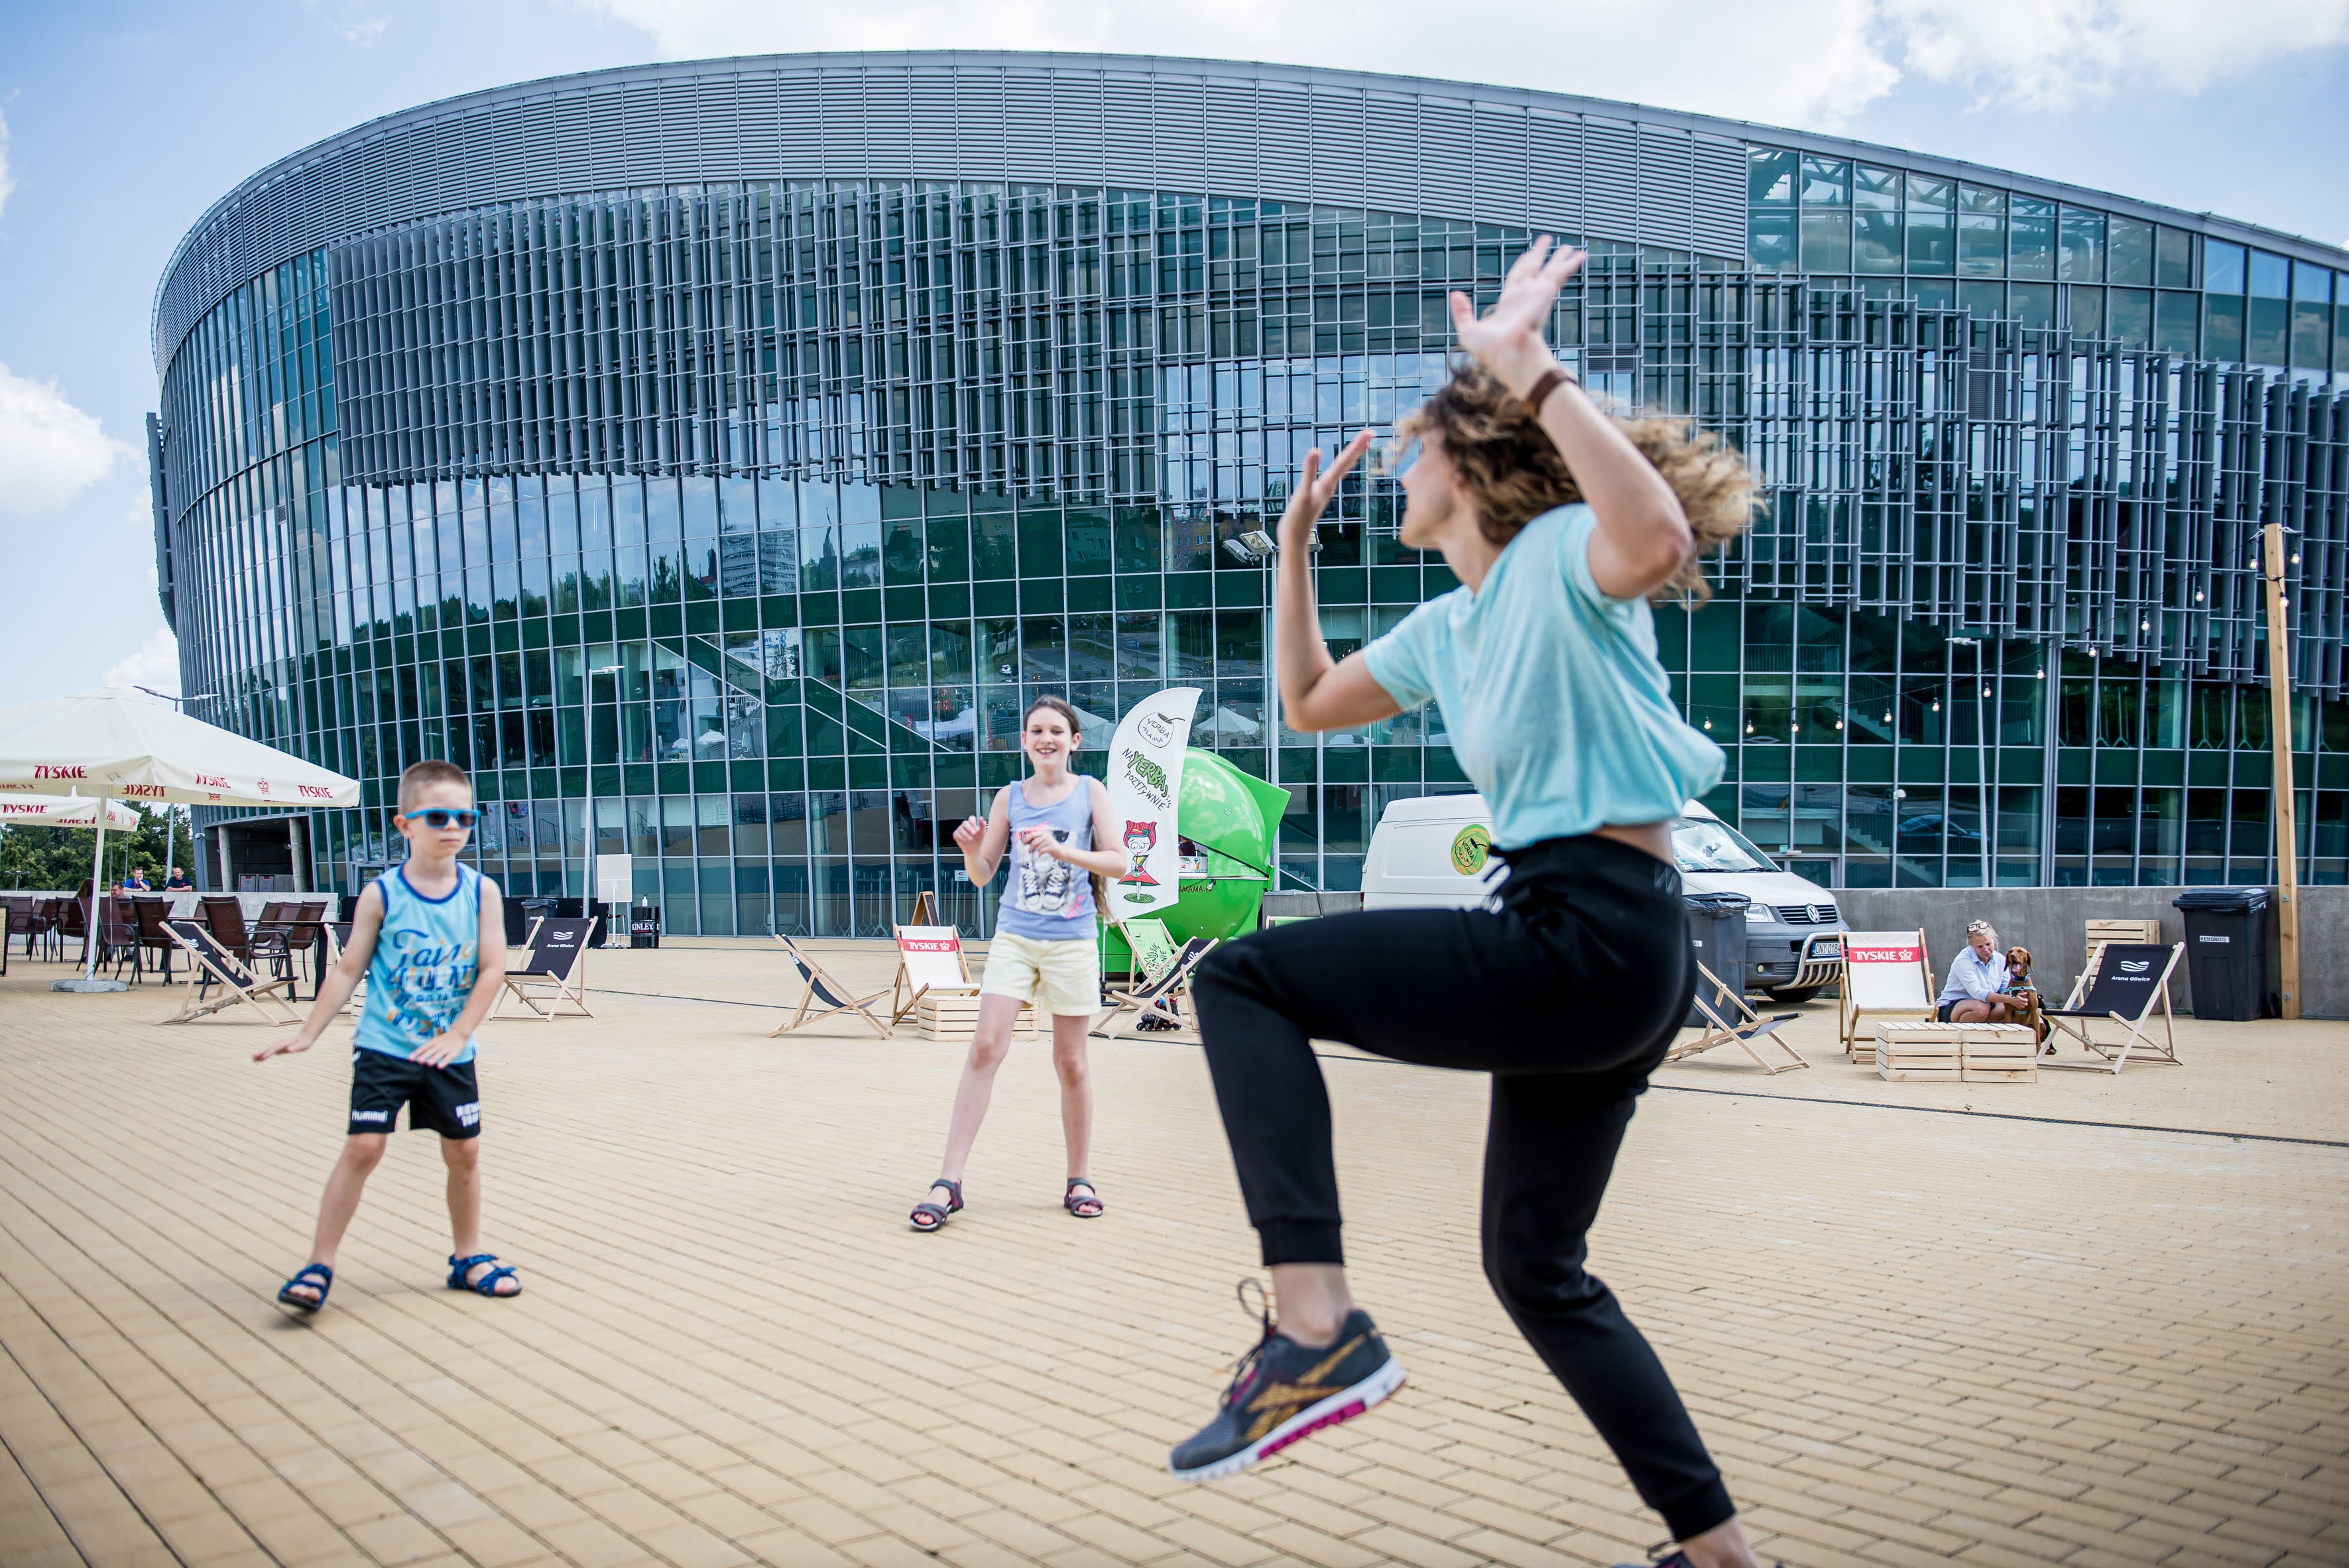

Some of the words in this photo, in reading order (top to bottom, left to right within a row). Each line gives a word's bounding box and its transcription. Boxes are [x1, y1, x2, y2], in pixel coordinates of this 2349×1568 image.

[1143, 726, 1164, 743] MAMA
[1147, 718, 1170, 739] YERBA
[34, 765, 88, 779] TYSKIE
[193, 772, 231, 788] TYSKIE
[298, 785, 333, 798] TYSKIE
[1, 804, 48, 814] TYSKIE
[1461, 840, 1475, 860] YERBA
[908, 941, 939, 950] TYSKIE
[1854, 951, 1897, 961] TYSKIE
